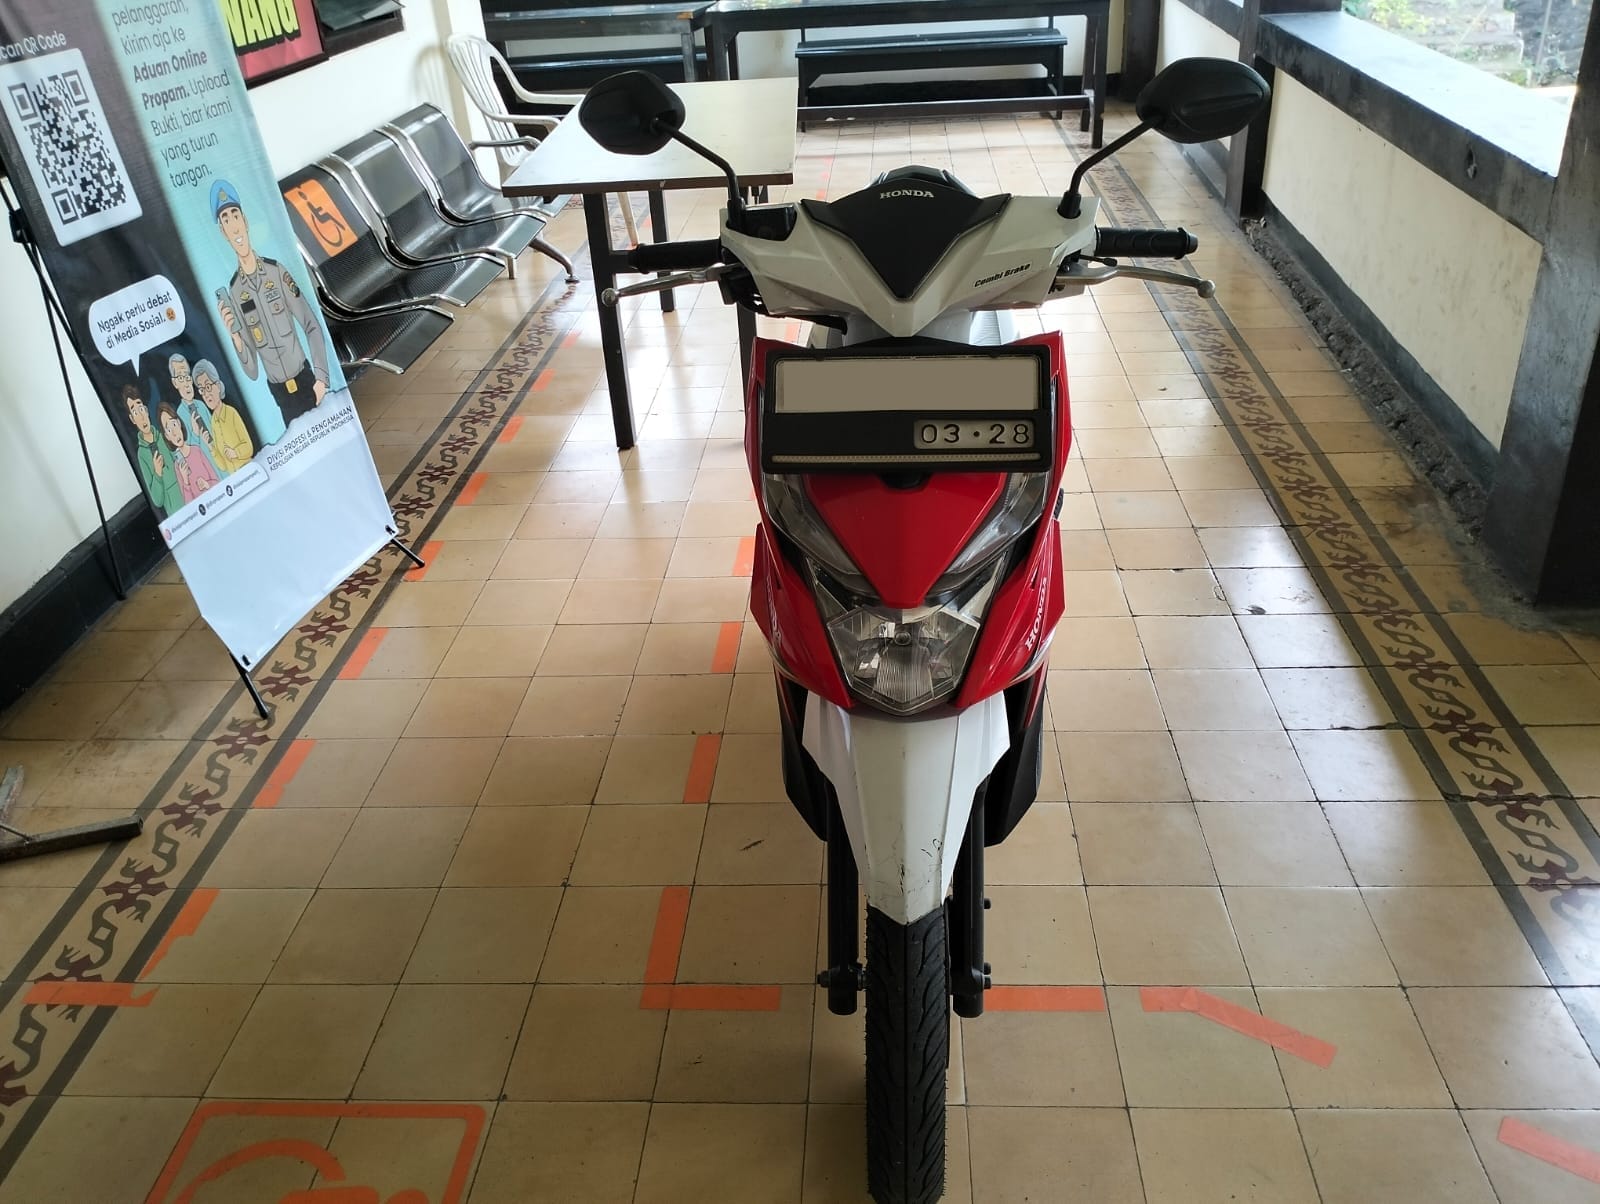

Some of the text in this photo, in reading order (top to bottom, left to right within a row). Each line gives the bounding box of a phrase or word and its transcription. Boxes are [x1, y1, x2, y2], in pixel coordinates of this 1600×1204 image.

[112, 0, 189, 32] pelanggaran,
[0, 30, 67, 59] can QR Code
[121, 26, 186, 56] kirim aja ke
[133, 49, 208, 83] Aduan Online
[142, 69, 230, 110] Propam. Upload
[151, 96, 232, 136] Bukti, biar kami
[161, 132, 219, 168] yang turun
[170, 163, 212, 188] tangan.
[880, 189, 934, 199] HONDA
[97, 291, 172, 333] Nggak perlu debat
[106, 313, 167, 349] di Media Sosial.
[284, 432, 309, 453] PROFESI
[311, 405, 352, 434] PENGAMANAN
[1024, 577, 1047, 651] HONDA
